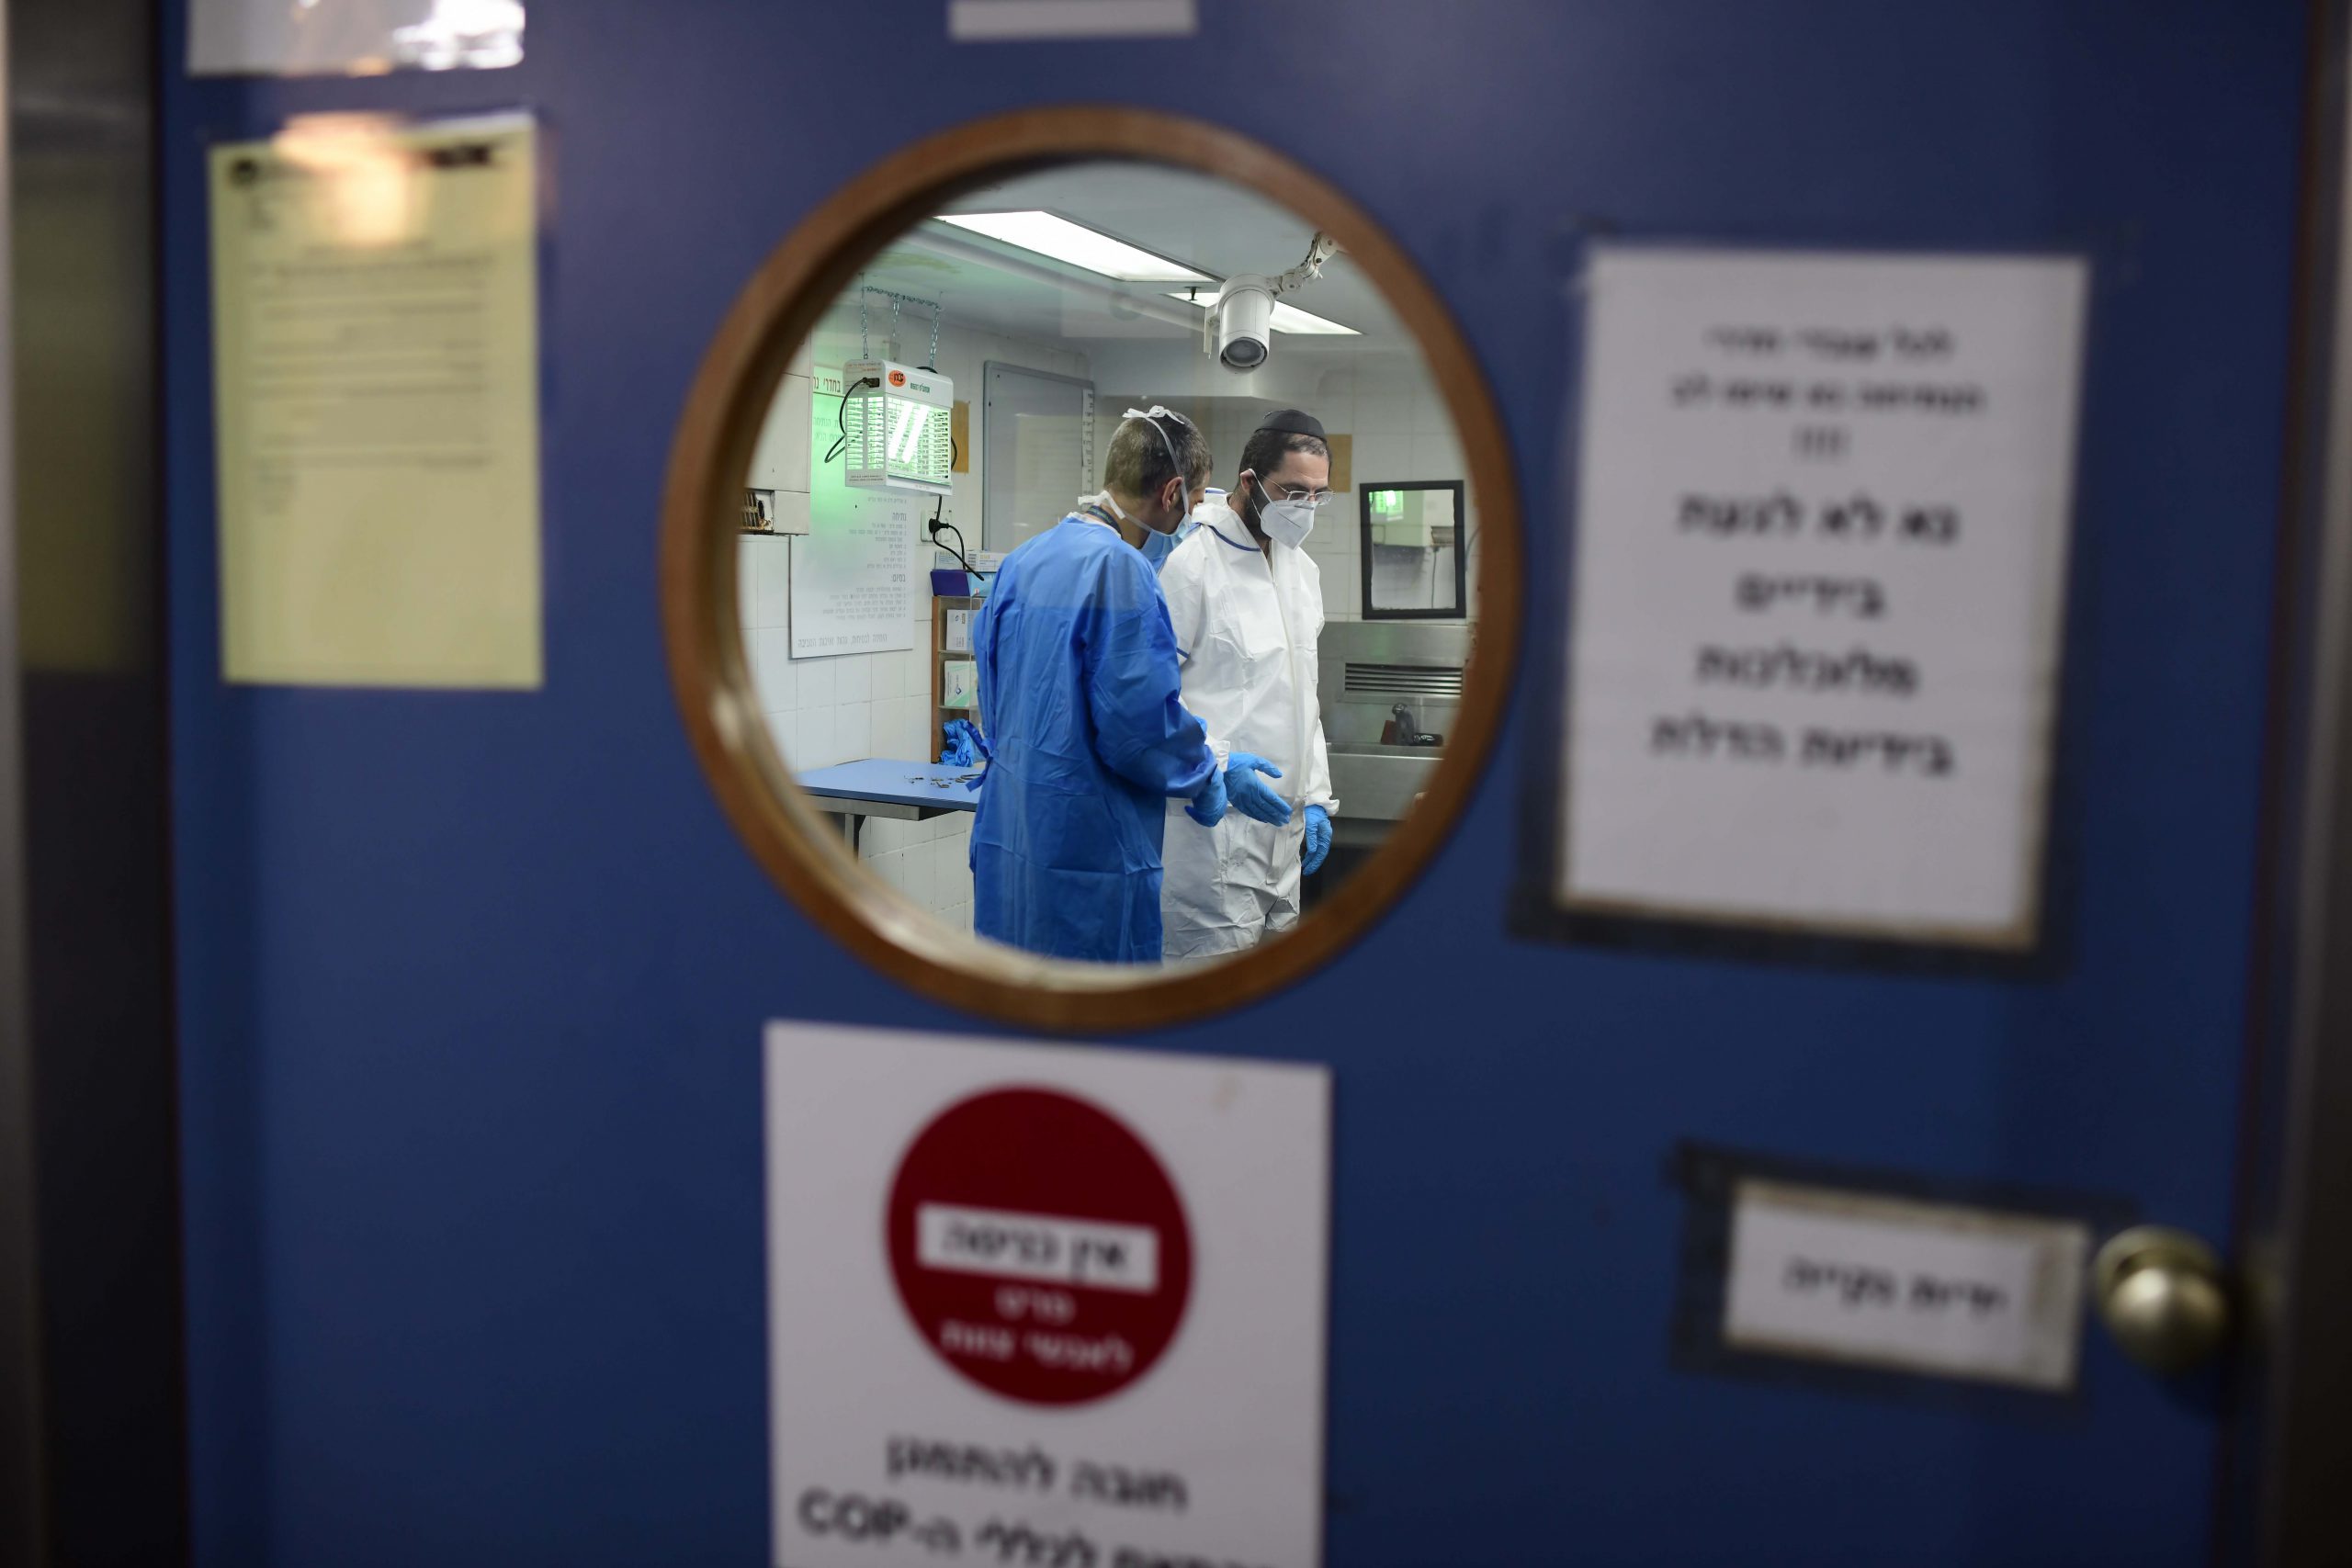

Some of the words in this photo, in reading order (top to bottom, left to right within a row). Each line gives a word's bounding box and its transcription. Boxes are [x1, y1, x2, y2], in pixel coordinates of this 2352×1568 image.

[1679, 490, 1805, 537] לגעת
[1818, 492, 1885, 537] לא
[1898, 506, 1960, 547] נא
[1735, 572, 1889, 620] בידיים
[1696, 643, 1921, 698] מלוכלכות
[1650, 712, 1786, 763] הדלת
[1801, 728, 1955, 778] בידיות
[942, 1222, 1060, 1267] כניסה
[1069, 1233, 1129, 1280] אין
[993, 1284, 1076, 1325] פרט
[939, 1320, 1015, 1361] צוות
[1024, 1332, 1135, 1376] לאנשי
[886, 1436, 1057, 1495] להתמגן
[1070, 1461, 1189, 1514] חובה
